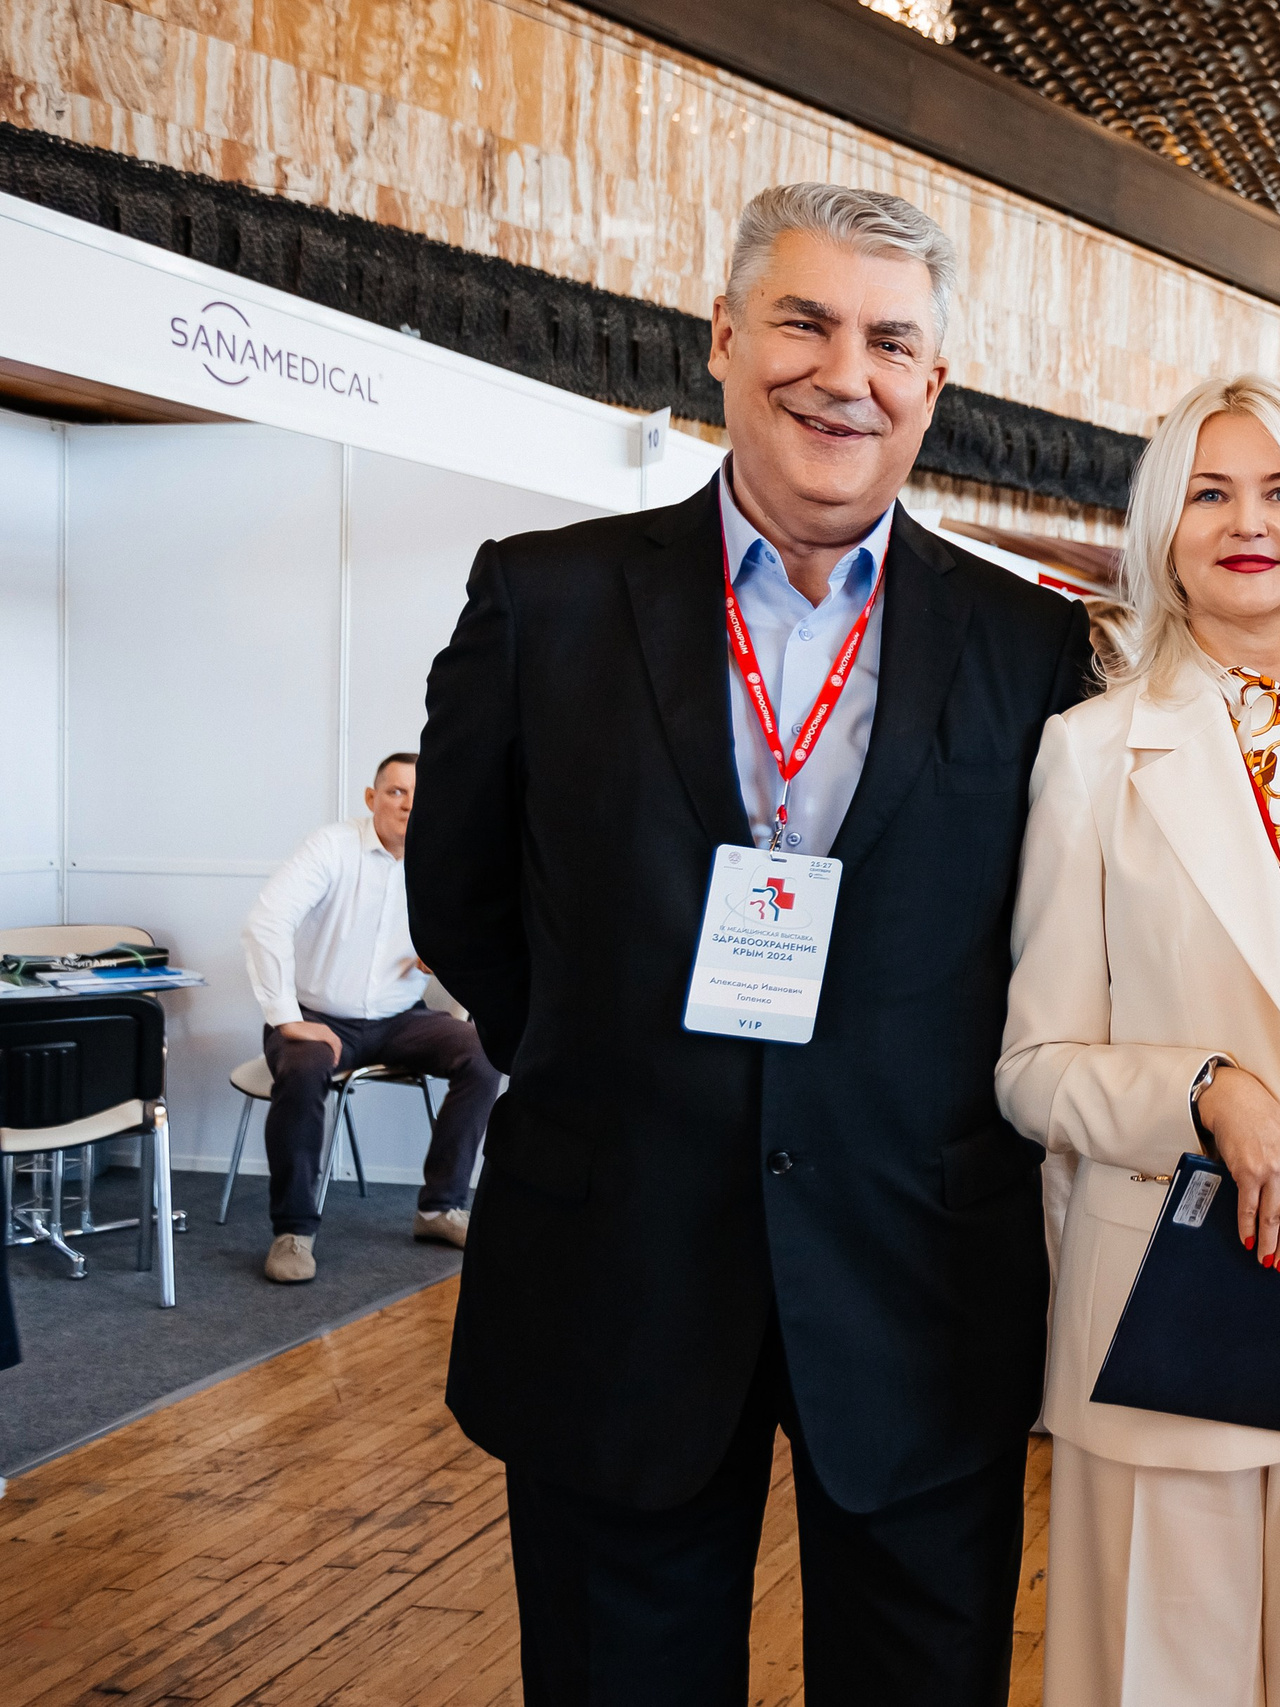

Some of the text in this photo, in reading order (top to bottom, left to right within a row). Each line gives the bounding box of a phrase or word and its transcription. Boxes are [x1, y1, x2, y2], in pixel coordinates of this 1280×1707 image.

[170, 317, 379, 405] SANAMEDICAL
[649, 429, 659, 449] 10
[728, 608, 749, 655] ЭКСПОКРЫМ
[837, 631, 860, 676] ЭКСПОКРЫМ
[754, 685, 774, 734] EXPOCRIMEA
[801, 703, 830, 750] EXPOCRIMEA
[811, 861, 833, 869] 25-27
[712, 933, 818, 954] ЗДРАВООХРАНЕНИЕ
[727, 926, 780, 939] МЕДИЦИНСКАЯ
[780, 933, 814, 942] ВЫСТАВКА
[732, 947, 793, 962] КРЫМ 2024
[709, 977, 803, 995] Александр Иванович
[736, 993, 772, 1005] Голенко
[738, 1019, 762, 1030] VIP
